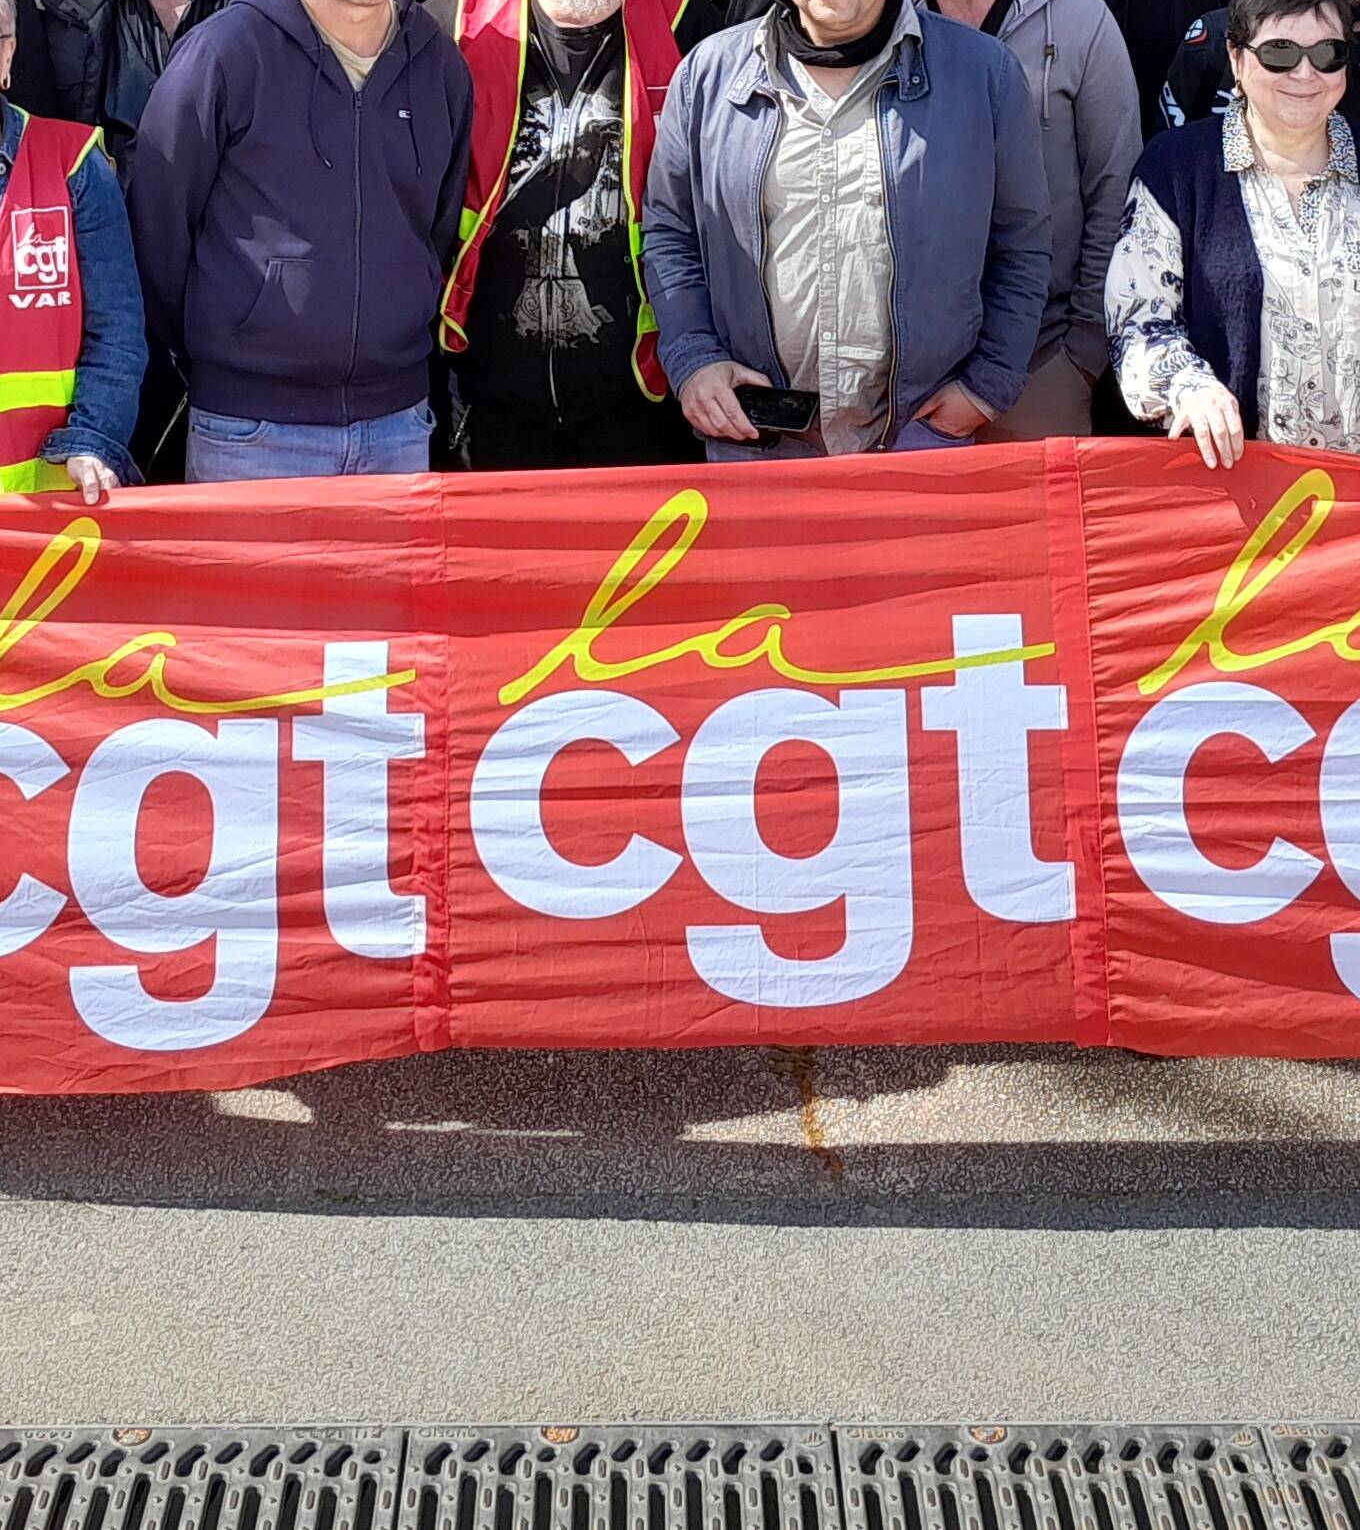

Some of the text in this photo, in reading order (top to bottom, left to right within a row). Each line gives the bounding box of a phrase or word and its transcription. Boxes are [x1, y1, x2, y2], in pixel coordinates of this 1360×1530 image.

[8, 291, 72, 308] VAR
[16, 236, 68, 284] cgt
[498, 488, 1055, 706] la
[469, 613, 1076, 1008] cgt
